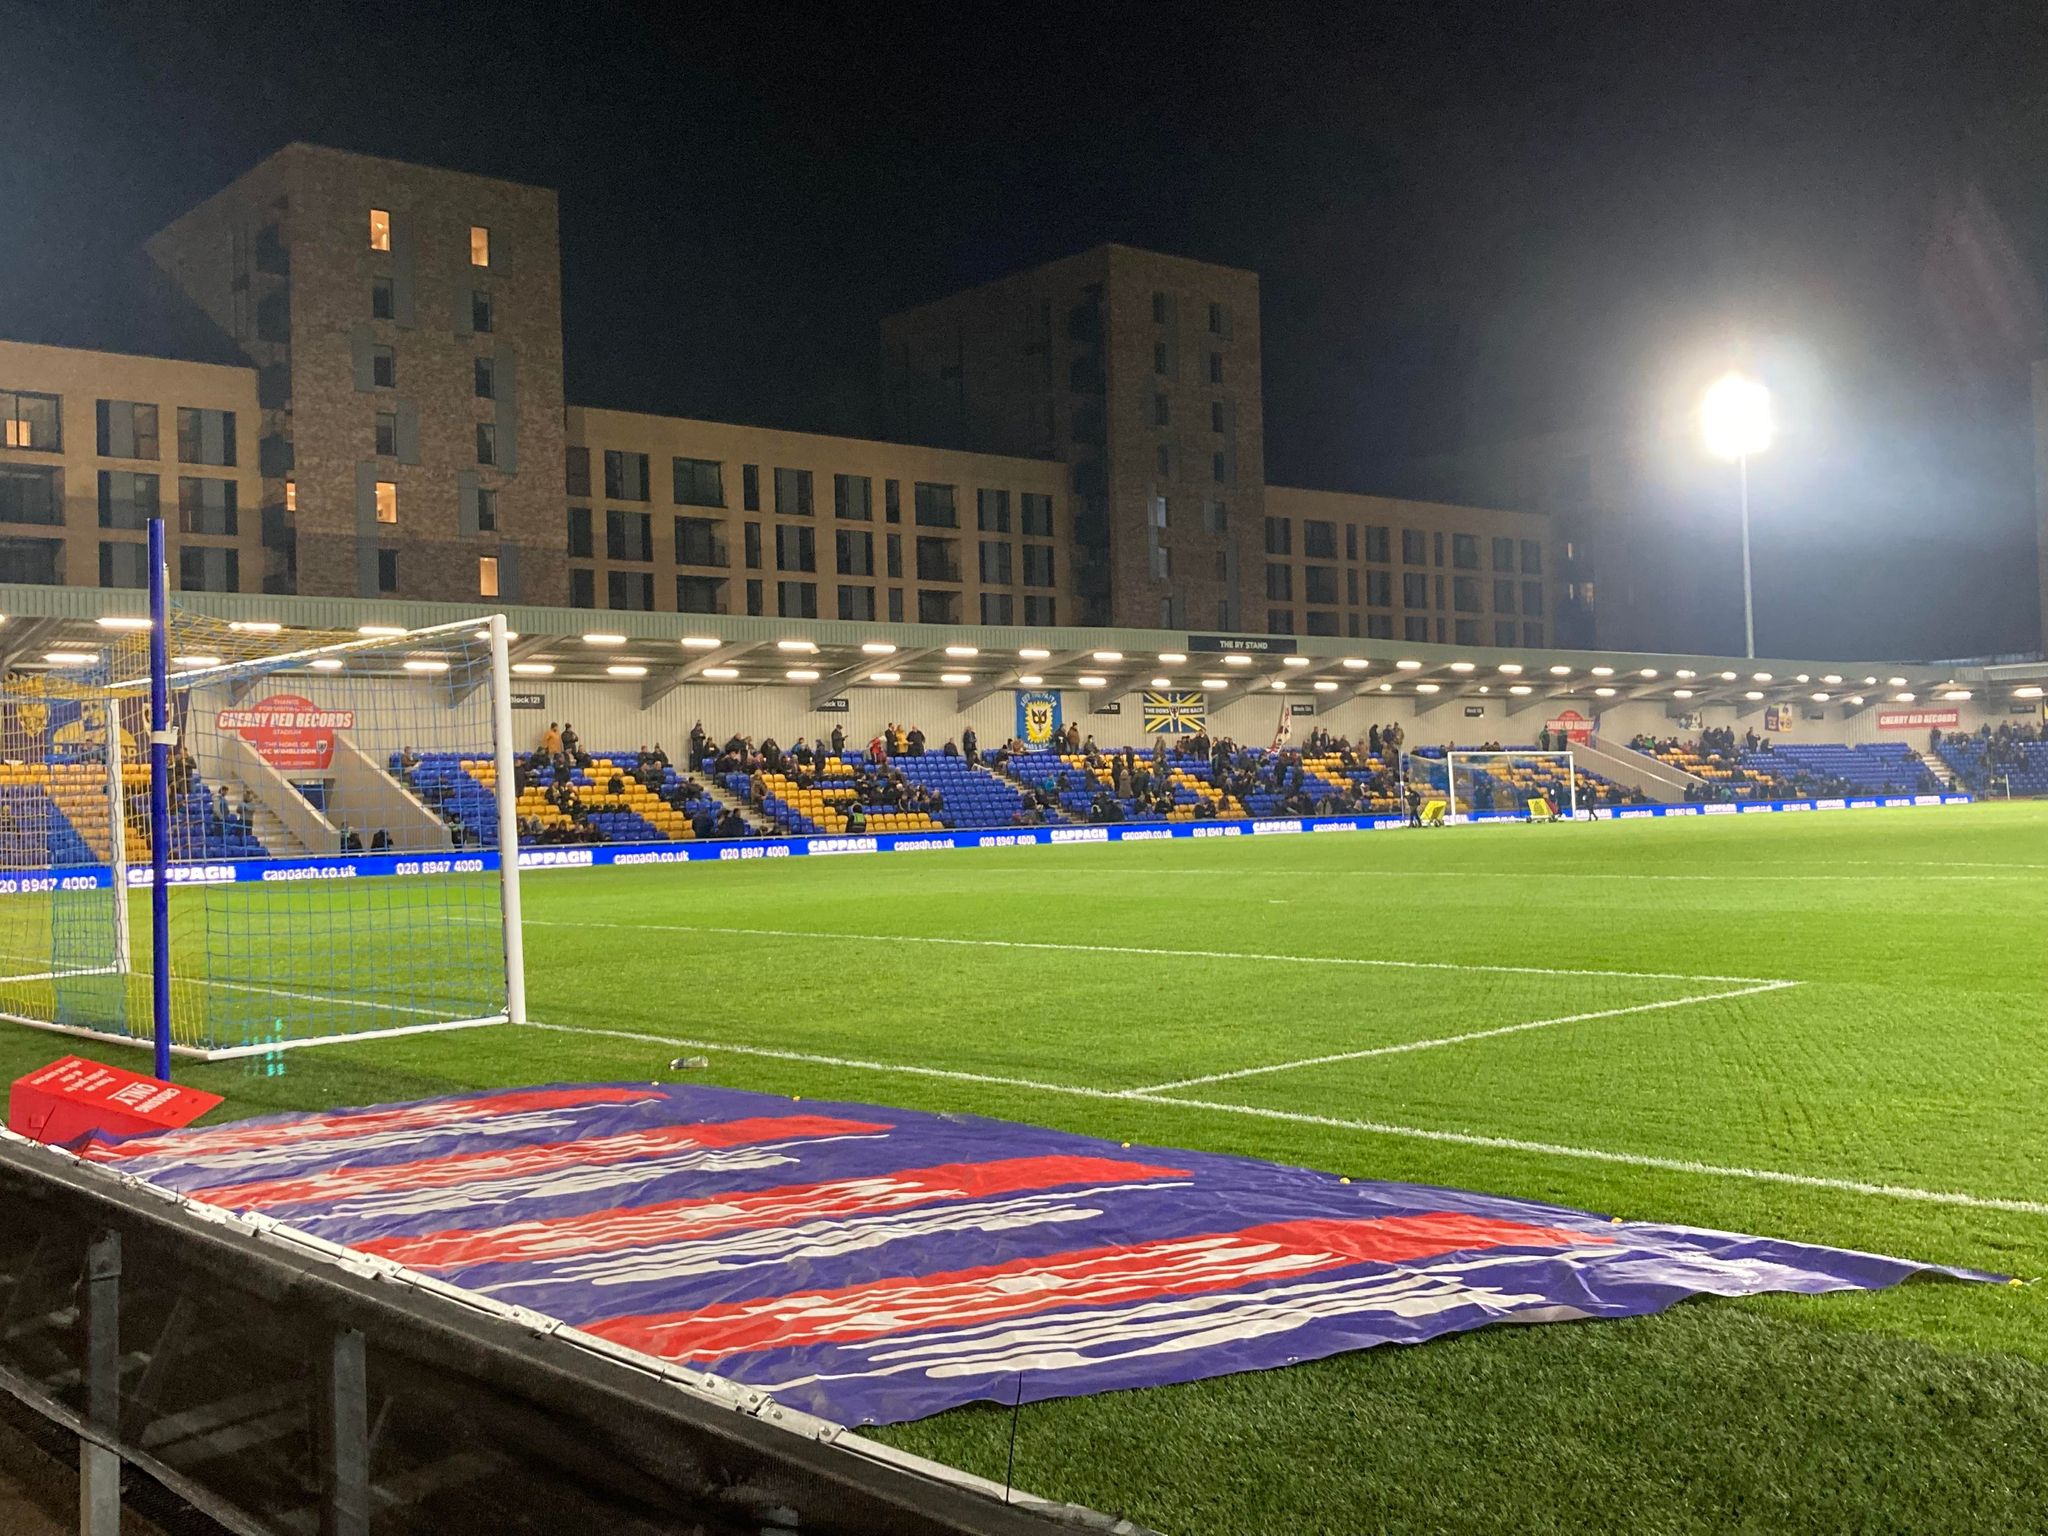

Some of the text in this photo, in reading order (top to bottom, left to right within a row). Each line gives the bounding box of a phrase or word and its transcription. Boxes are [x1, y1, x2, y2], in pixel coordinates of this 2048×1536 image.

[1220, 640, 1268, 650] THE RY STAND
[530, 696, 541, 704] 121
[218, 712, 353, 728] CHERRY RED RECORDS
[1923, 713, 1958, 724] RECORDS
[1253, 820, 1301, 831] CAPPAGH
[980, 835, 1036, 847] 020 8947 4000
[1051, 829, 1108, 841] CAPPAGH
[808, 839, 877, 852] CAPPAGH
[518, 851, 592, 865] APPAGH
[614, 850, 690, 864] cappagh.co.uk
[720, 846, 789, 860] 020 8947 4000
[263, 865, 357, 881] cappagh.co.uk
[396, 859, 484, 876] 020 8947 4000
[0, 875, 97, 893] 20 8947 4000
[114, 1083, 159, 1106] ONLY
